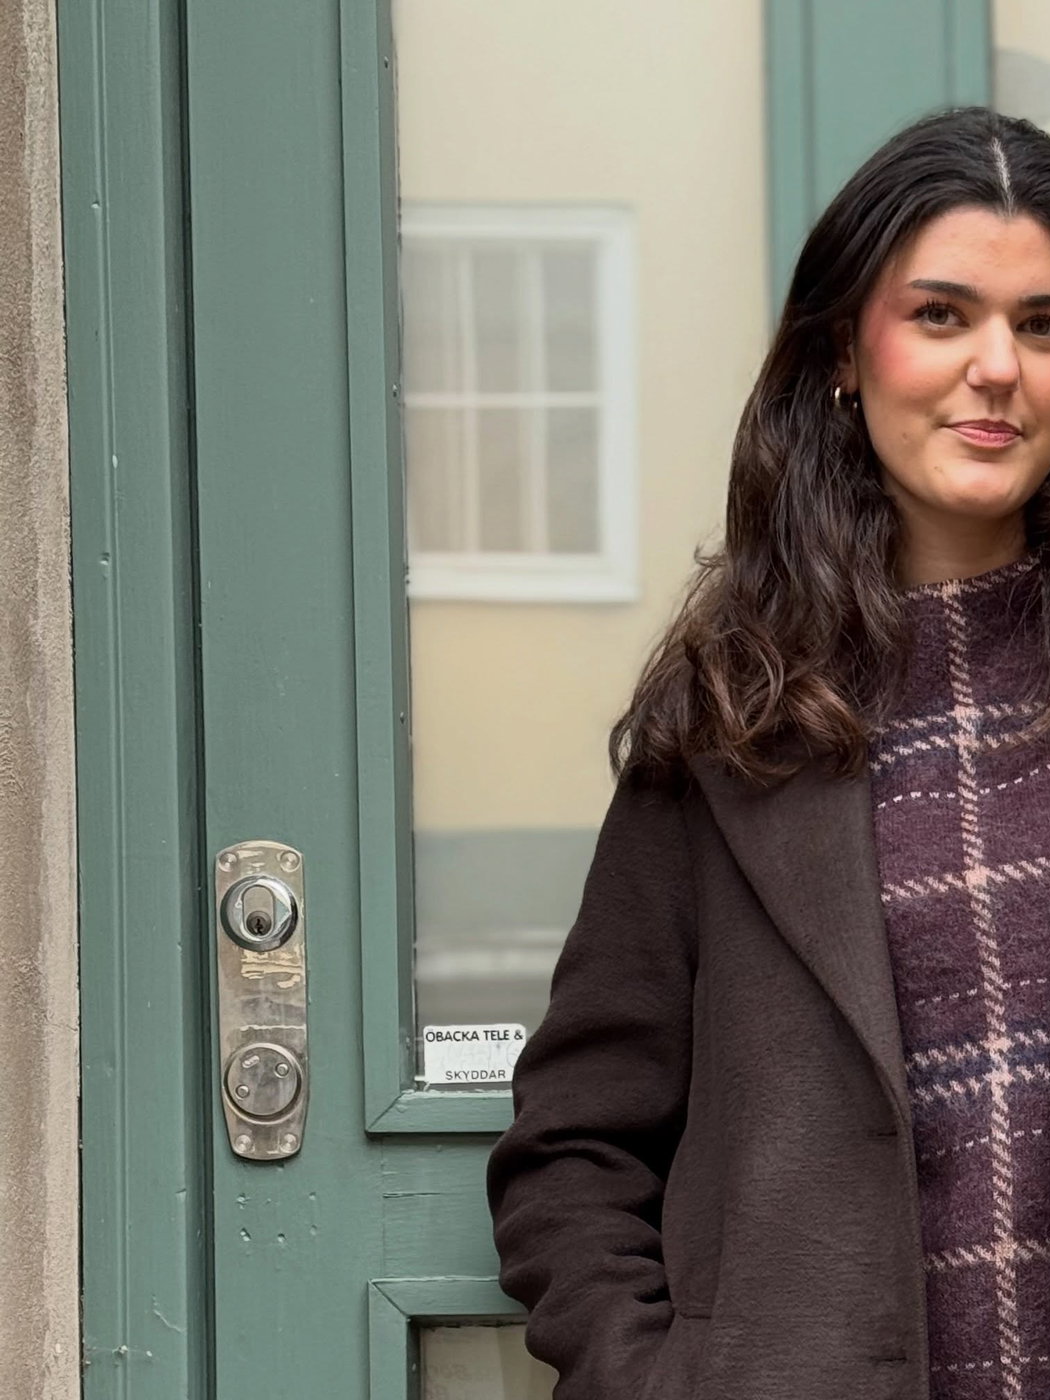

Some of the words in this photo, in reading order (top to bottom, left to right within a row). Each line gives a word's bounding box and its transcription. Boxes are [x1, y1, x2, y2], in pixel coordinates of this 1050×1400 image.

[483, 1030, 510, 1041] TELE
[513, 1029, 524, 1041] &
[445, 1070, 506, 1082] SKYDDAR
